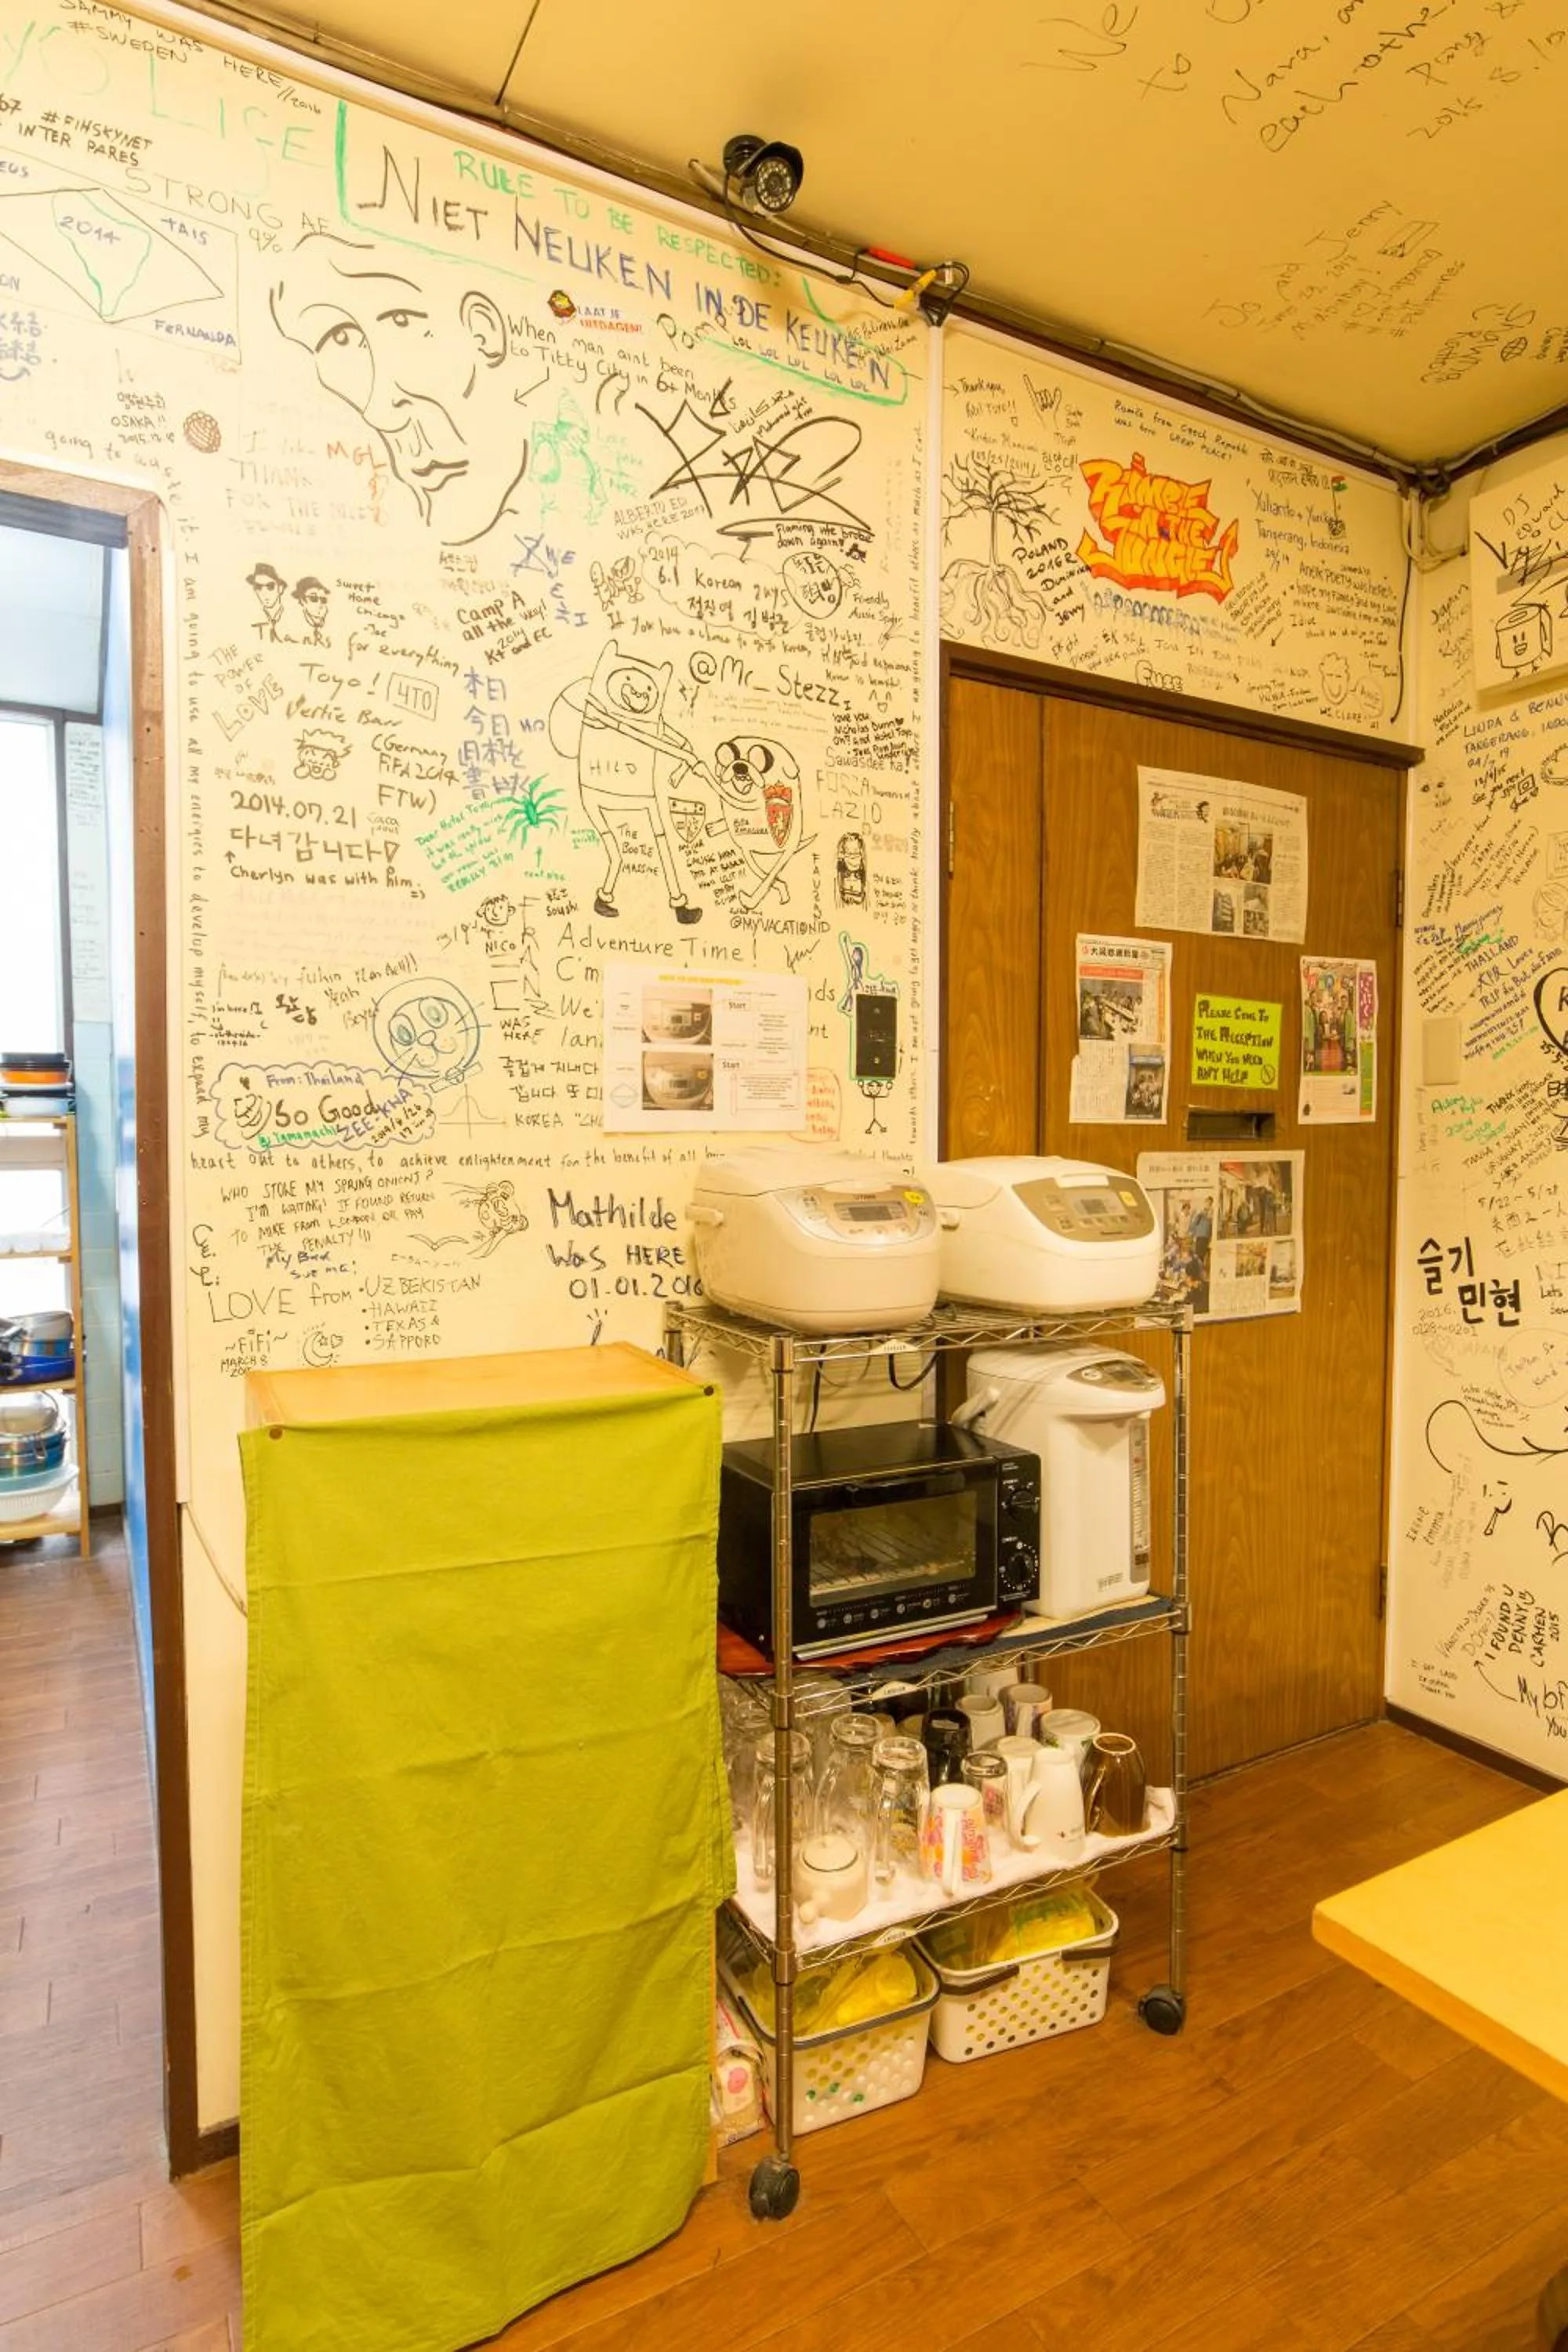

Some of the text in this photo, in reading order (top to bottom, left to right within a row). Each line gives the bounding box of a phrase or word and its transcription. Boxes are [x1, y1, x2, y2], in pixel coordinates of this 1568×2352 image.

[67, 20, 188, 64] #SWEDEN
[157, 29, 204, 53] WAS
[87, 140, 140, 167] PARES
[125, 166, 283, 230] STRONG
[454, 150, 536, 198] RULE
[553, 187, 590, 220] TO
[608, 208, 634, 234] BE
[59, 216, 122, 245] 2014
[381, 144, 488, 241] NIET
[514, 194, 673, 300] NEUKEN
[695, 281, 722, 314] IN
[732, 294, 772, 330] DE
[786, 309, 891, 390] KEUKEN
[154, 319, 237, 347] FERNANDA
[507, 314, 557, 345] When
[572, 338, 604, 356] man
[659, 355, 695, 379] been
[510, 339, 529, 357] to
[539, 346, 588, 383] Titty
[596, 361, 630, 392] City
[635, 372, 649, 385] in
[777, 536, 804, 549] down
[1011, 537, 1069, 565] POLAND
[695, 567, 742, 592] Korean
[456, 599, 505, 626] Camp
[462, 627, 485, 643] all
[485, 616, 514, 637] the
[347, 631, 370, 662] for
[379, 643, 460, 676] everything
[230, 865, 379, 887] Cherlyn was with
[485, 941, 517, 955] NICO
[557, 921, 674, 958] Adventure
[1465, 935, 1519, 974] THAILAND
[306, 1069, 365, 1087] Thailand
[275, 1089, 381, 1128] So Good
[515, 1112, 564, 1128] KOREA
[546, 1187, 678, 1231] Mathilde
[626, 1243, 687, 1269] HERE
[1417, 1236, 1475, 1295] 슬기
[208, 1283, 353, 1323] LOVE from
[1457, 1279, 1521, 1327] 민현
[1490, 1601, 1513, 1651] FOUND
[1508, 1603, 1530, 1654] DENNY
[1530, 1606, 1547, 1668] CARMEN
